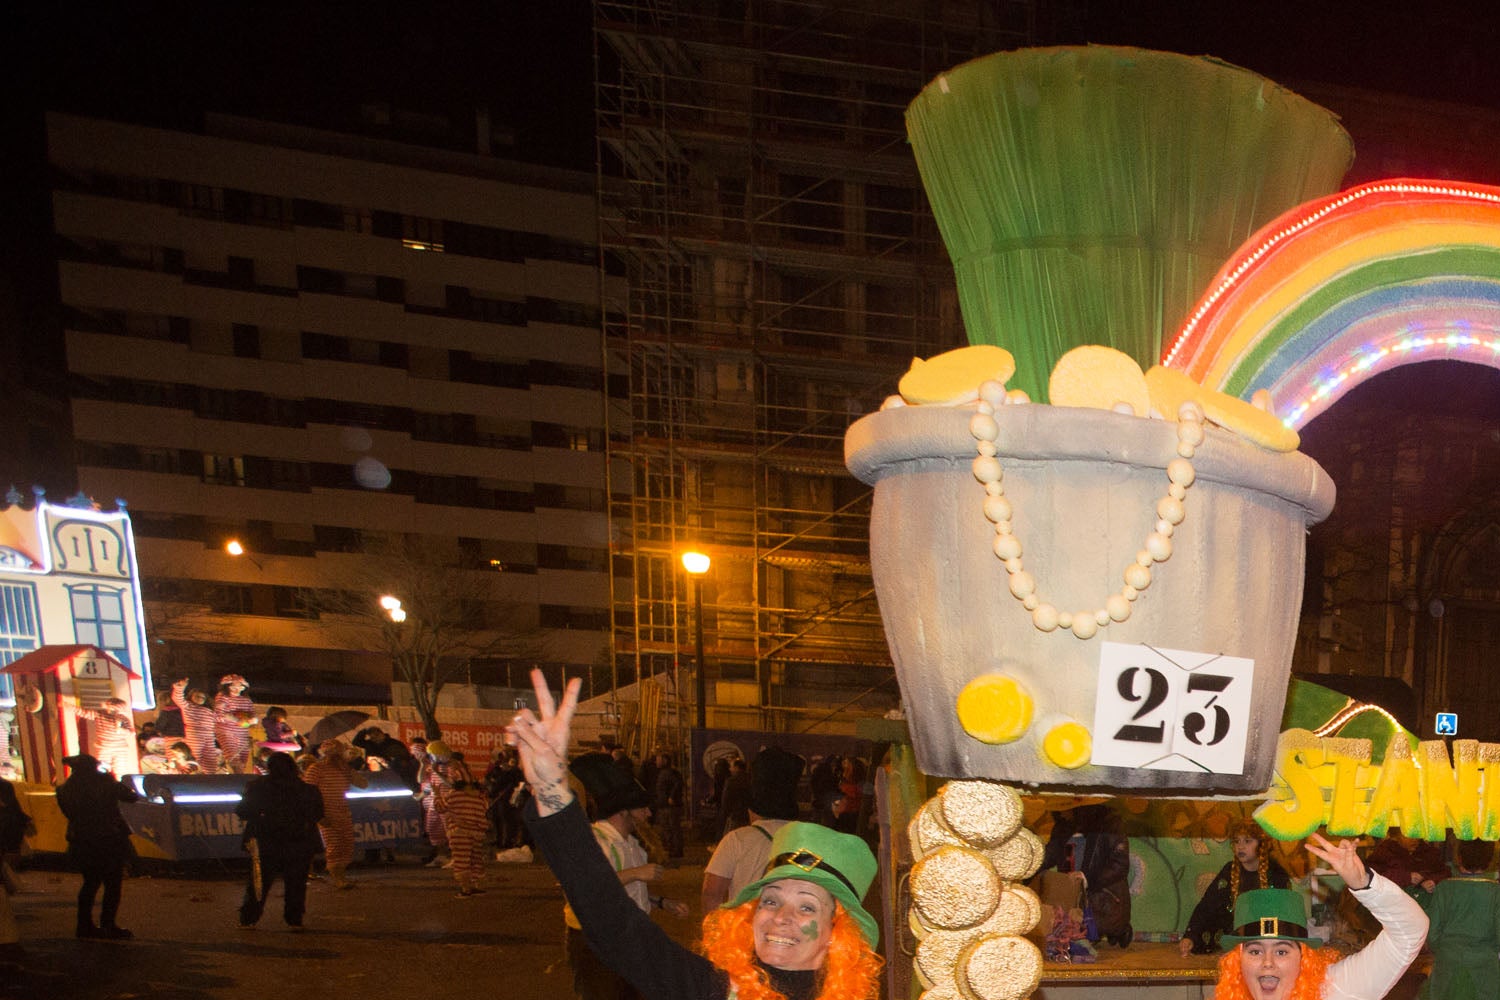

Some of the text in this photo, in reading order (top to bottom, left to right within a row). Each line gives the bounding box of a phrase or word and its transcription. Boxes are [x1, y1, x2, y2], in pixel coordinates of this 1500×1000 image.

[86, 661, 98, 675] 8
[1113, 666, 1235, 746] 23
[178, 812, 421, 843] BALNE SALINAS
